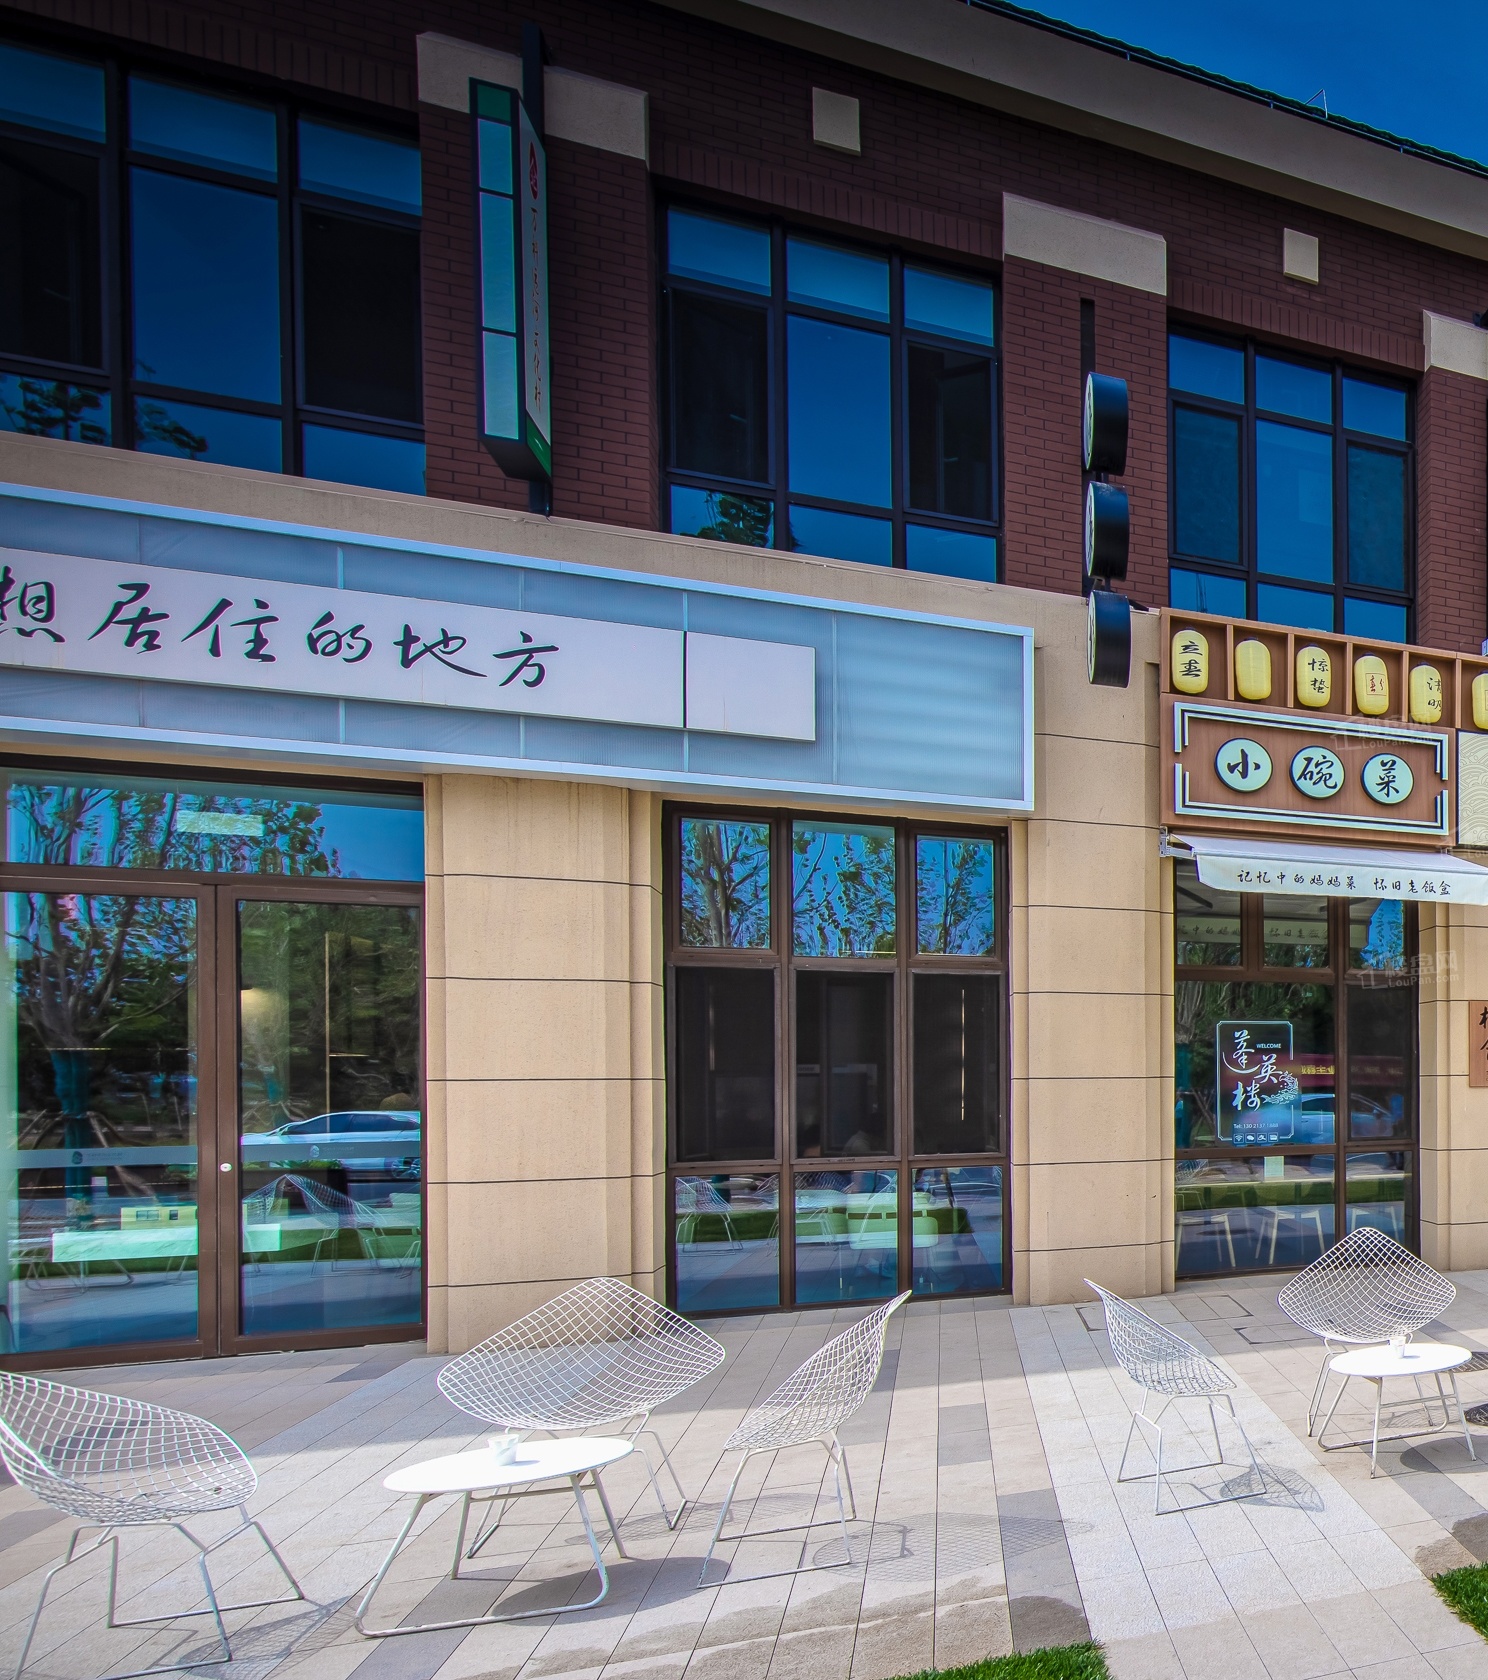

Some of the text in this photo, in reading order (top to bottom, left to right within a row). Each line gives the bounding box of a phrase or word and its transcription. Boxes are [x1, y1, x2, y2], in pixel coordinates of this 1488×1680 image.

[1179, 640, 1204, 678] 立春
[1227, 748, 1400, 798] 小碗菜
[1237, 869, 1452, 896] 记忆中的妈妈菜 怀旧老饭盒
